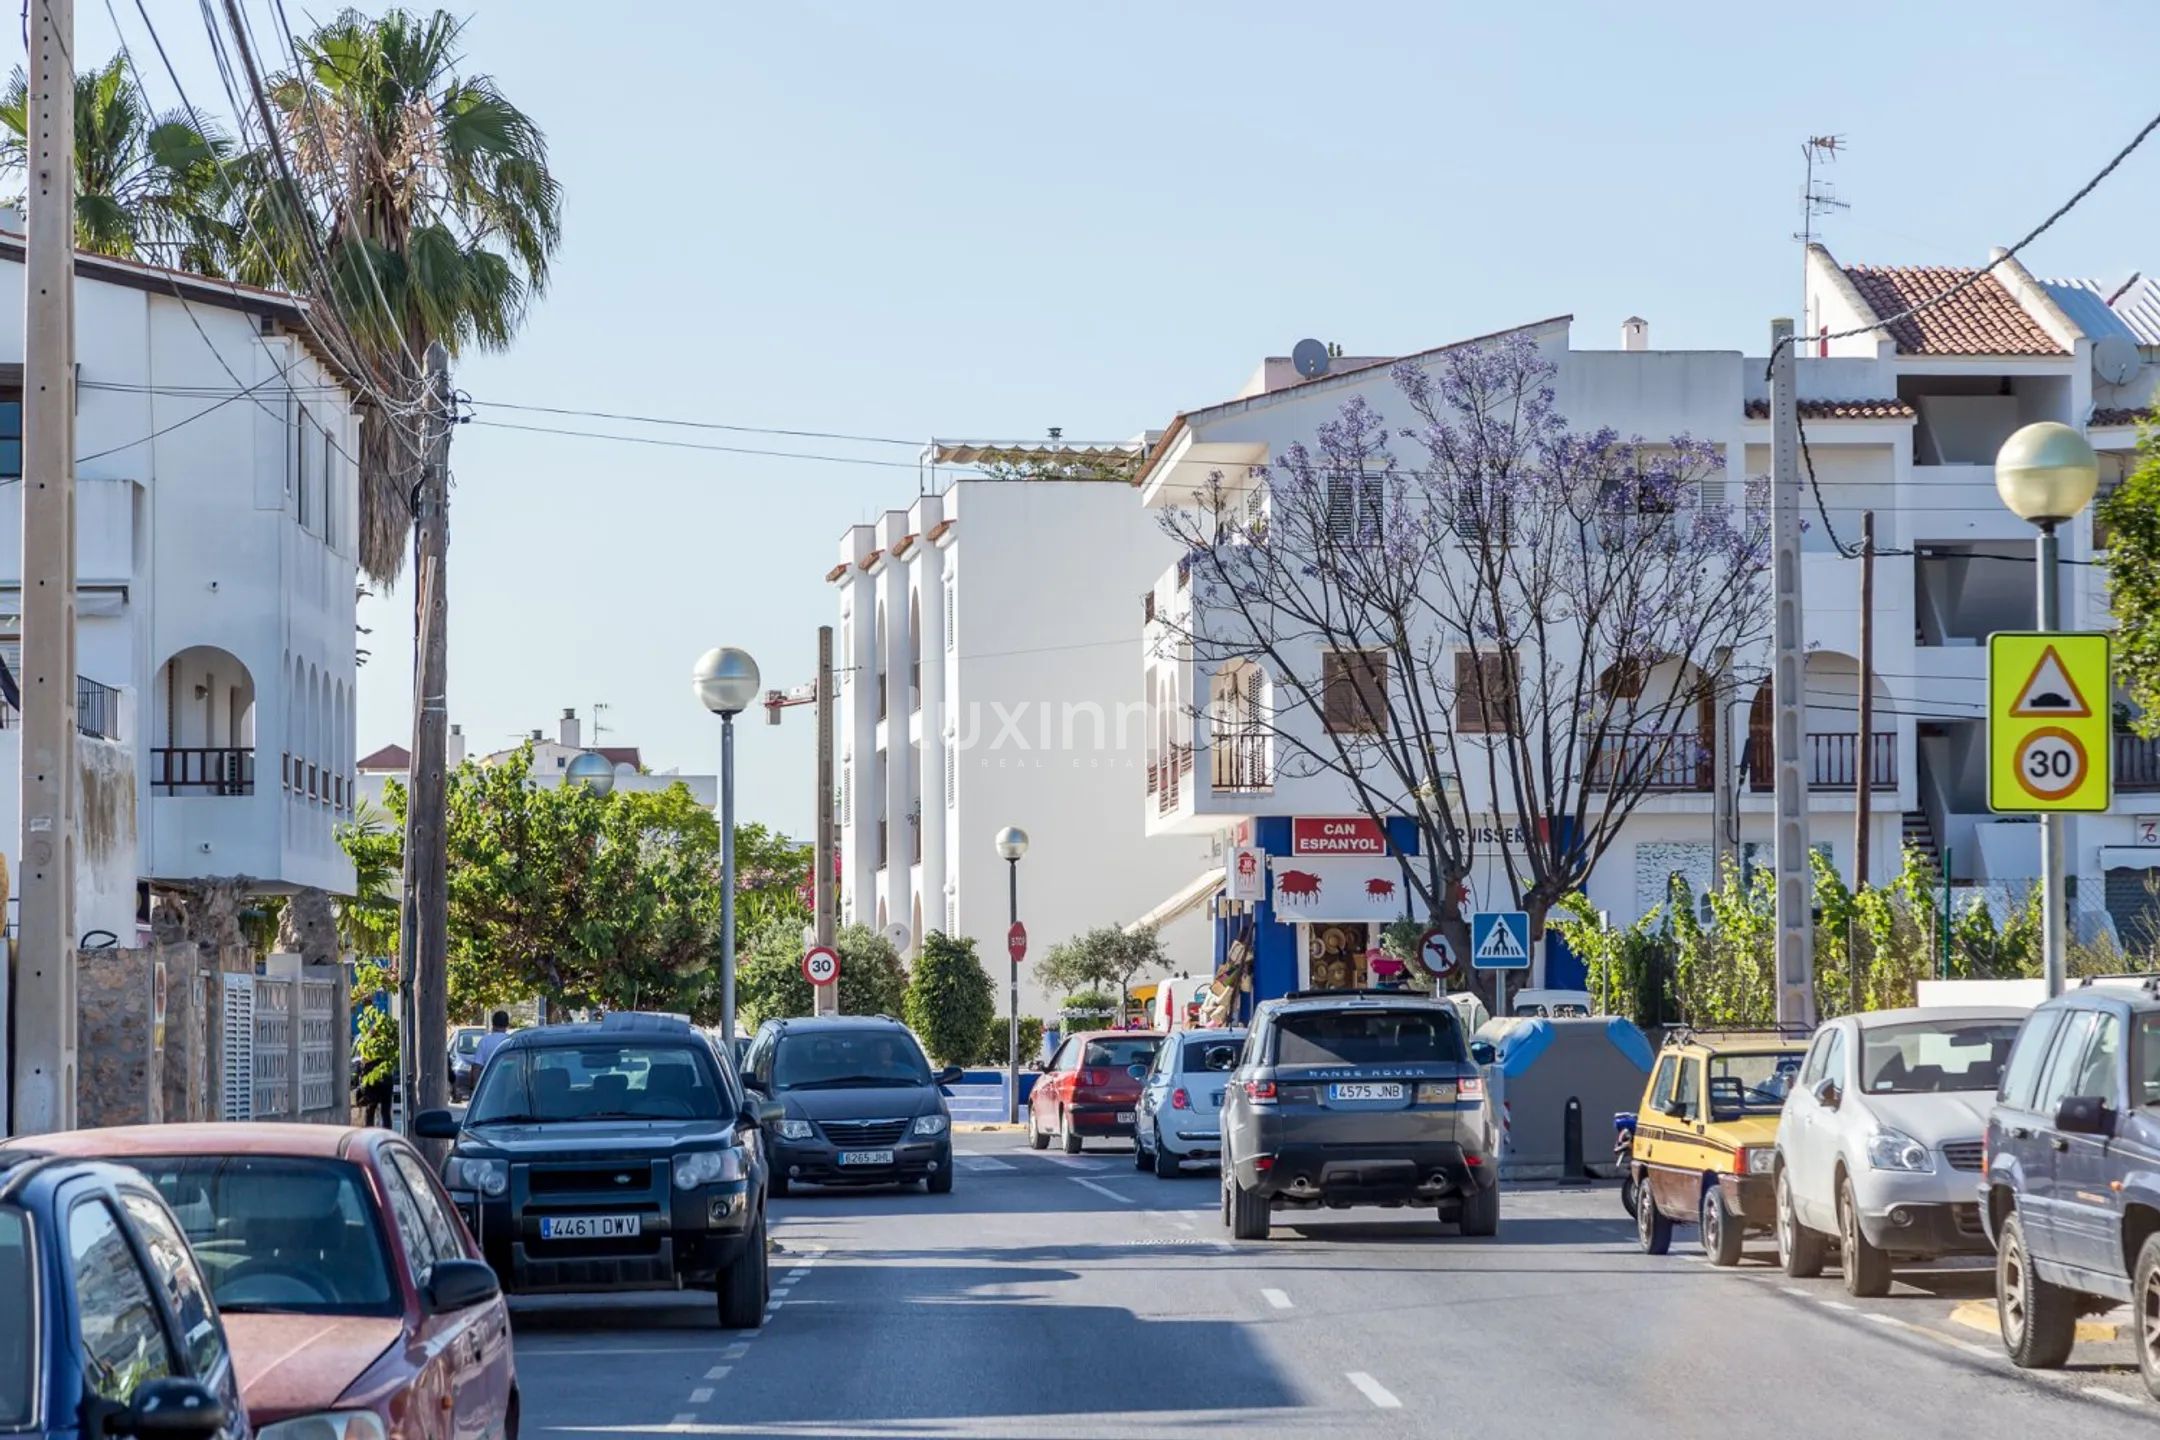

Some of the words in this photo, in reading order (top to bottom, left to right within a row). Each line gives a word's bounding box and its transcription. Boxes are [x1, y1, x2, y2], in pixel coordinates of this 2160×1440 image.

[2029, 750, 2071, 778] 30
[1323, 823, 1356, 835] CAN
[1300, 838, 1379, 850] ESPANYOL
[812, 960, 831, 972] 30
[1372, 1069, 1424, 1077] ROVER
[1339, 1085, 1371, 1098] 4575
[1377, 1084, 1400, 1097] JNB
[554, 1219, 596, 1236] 4461
[602, 1217, 635, 1235] DWV
